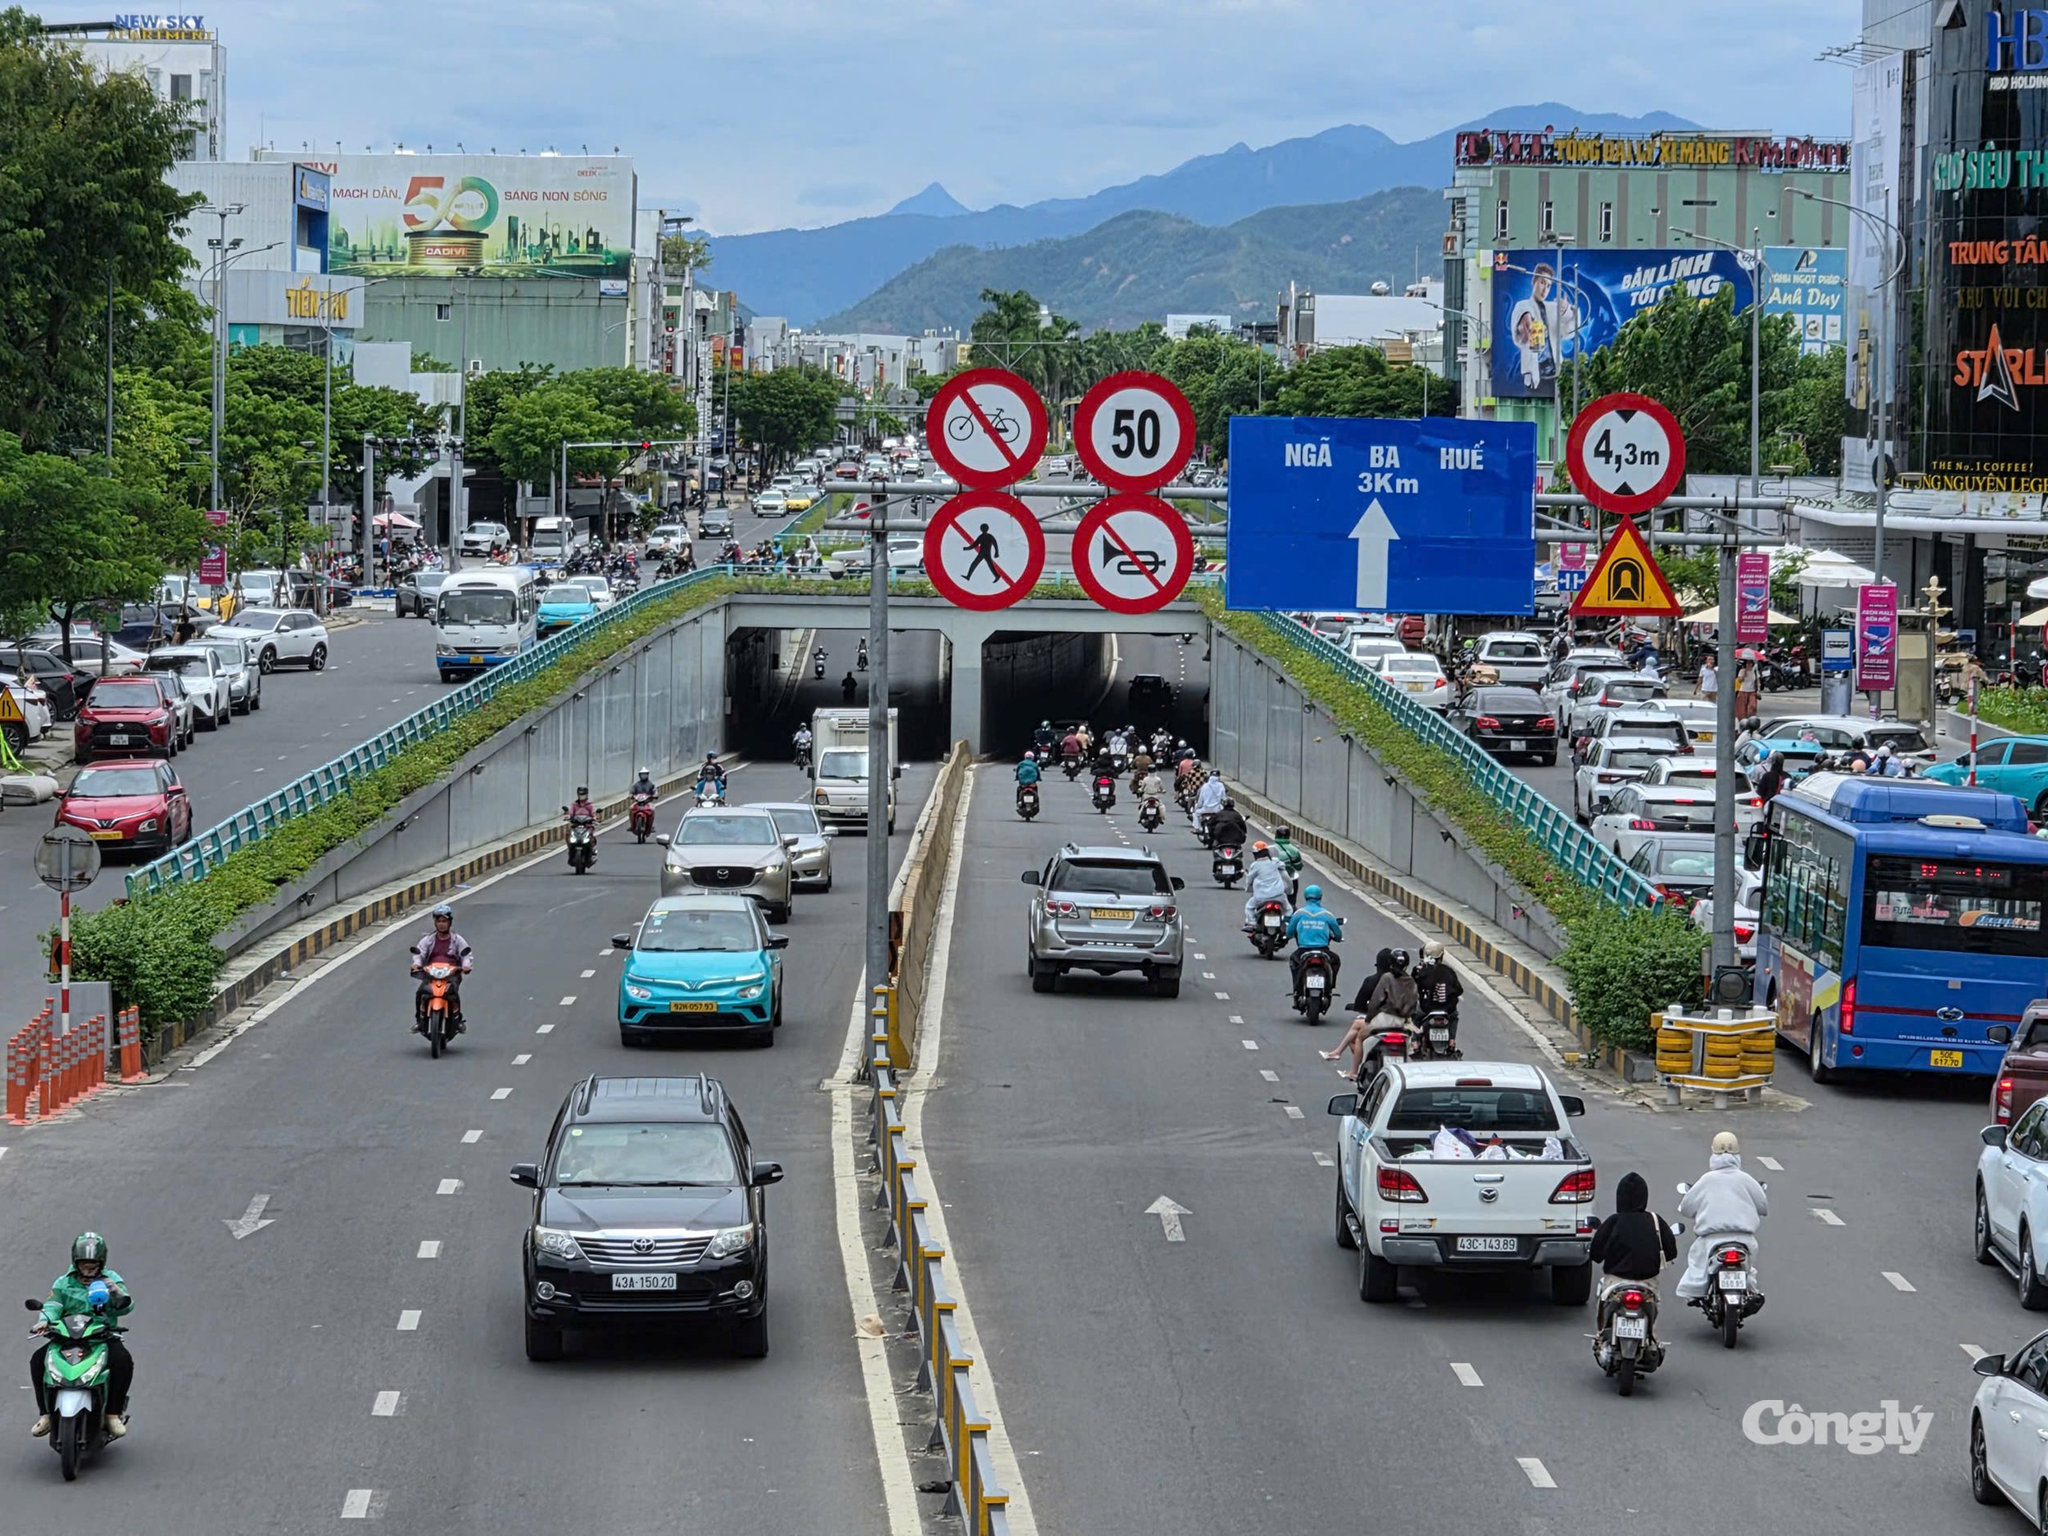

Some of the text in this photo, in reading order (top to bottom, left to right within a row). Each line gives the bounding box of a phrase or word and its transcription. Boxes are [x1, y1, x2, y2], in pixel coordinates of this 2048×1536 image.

[115, 14, 204, 30] NEW SKY
[1966, 141, 2011, 189] SIÊU
[542, 191, 569, 201] NON
[574, 190, 608, 201] SÔNG
[425, 248, 466, 256] CADIVI
[1949, 240, 2008, 265] TRUNG
[1768, 287, 1841, 310] Anh Duy
[1958, 289, 1983, 309] KHU
[1993, 288, 2019, 308] VUI
[1111, 409, 1160, 459] 50
[1285, 437, 1484, 470] NGÃ BA HUẾ
[1593, 429, 1660, 473] 4,3m
[1932, 461, 1952, 470] THE
[1983, 462, 2034, 472] COFFEE!
[1358, 472, 1419, 494] 3Km
[1943, 473, 2007, 492] NGUYÊN
